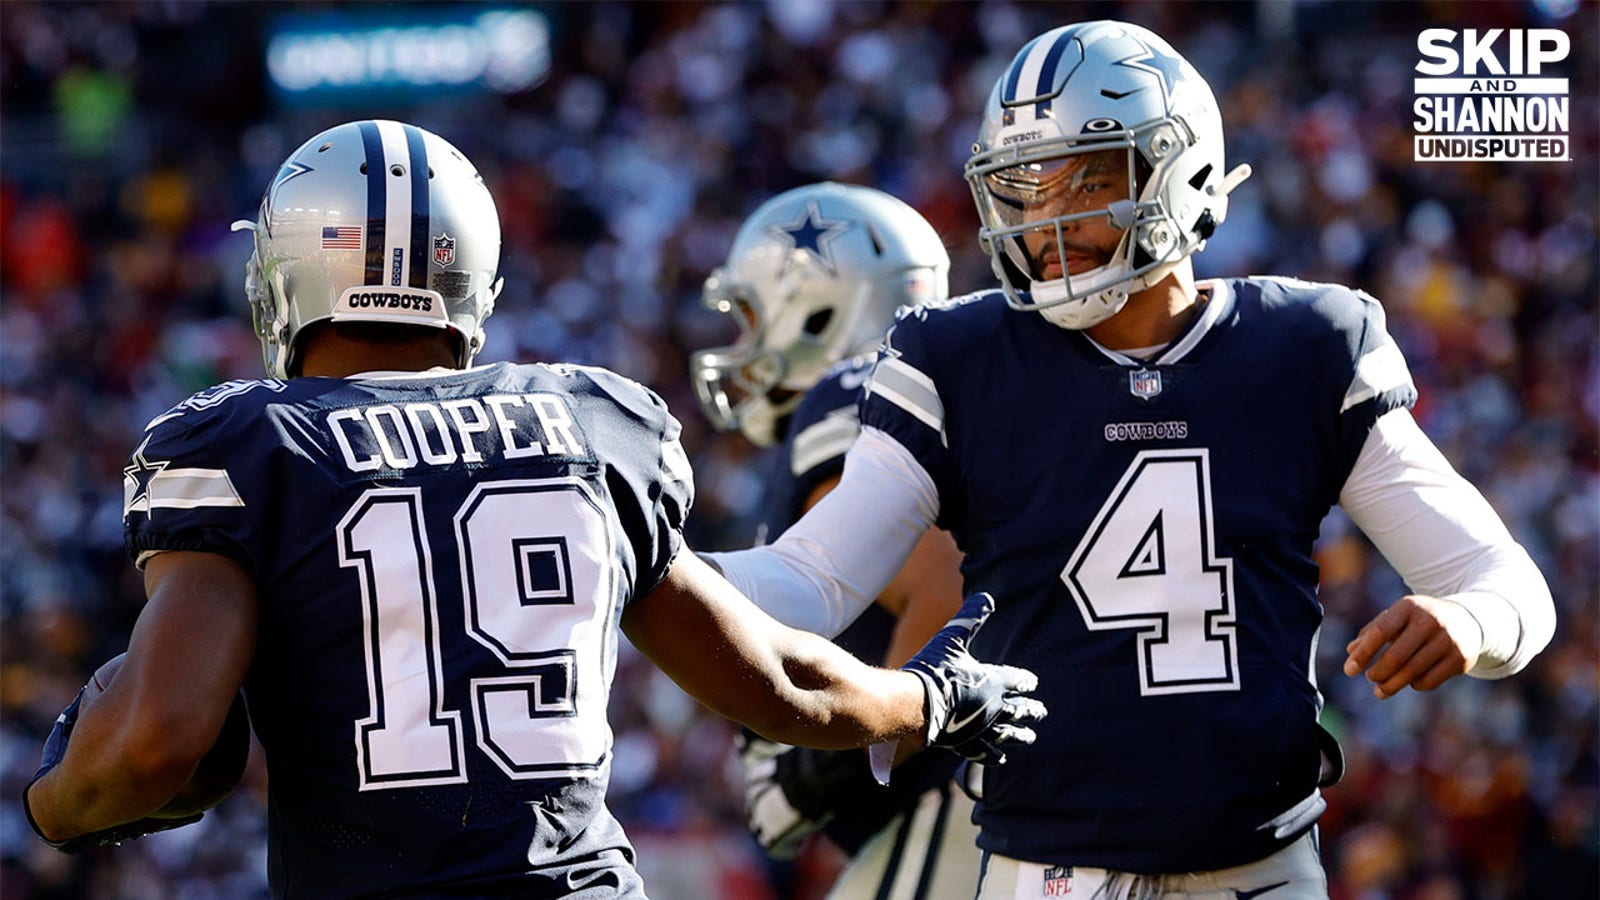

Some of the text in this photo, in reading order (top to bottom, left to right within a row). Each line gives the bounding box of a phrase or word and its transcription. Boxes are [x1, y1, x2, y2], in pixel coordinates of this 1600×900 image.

[435, 248, 454, 263] NFL
[393, 249, 402, 286] COOPER
[349, 292, 432, 312] COWBOYS
[1135, 378, 1158, 392] NFL
[326, 392, 584, 472] COOPER
[1104, 421, 1188, 441] COWBOYS
[1060, 447, 1241, 696] 4
[335, 475, 616, 792] 19
[1046, 878, 1072, 897] NFL
